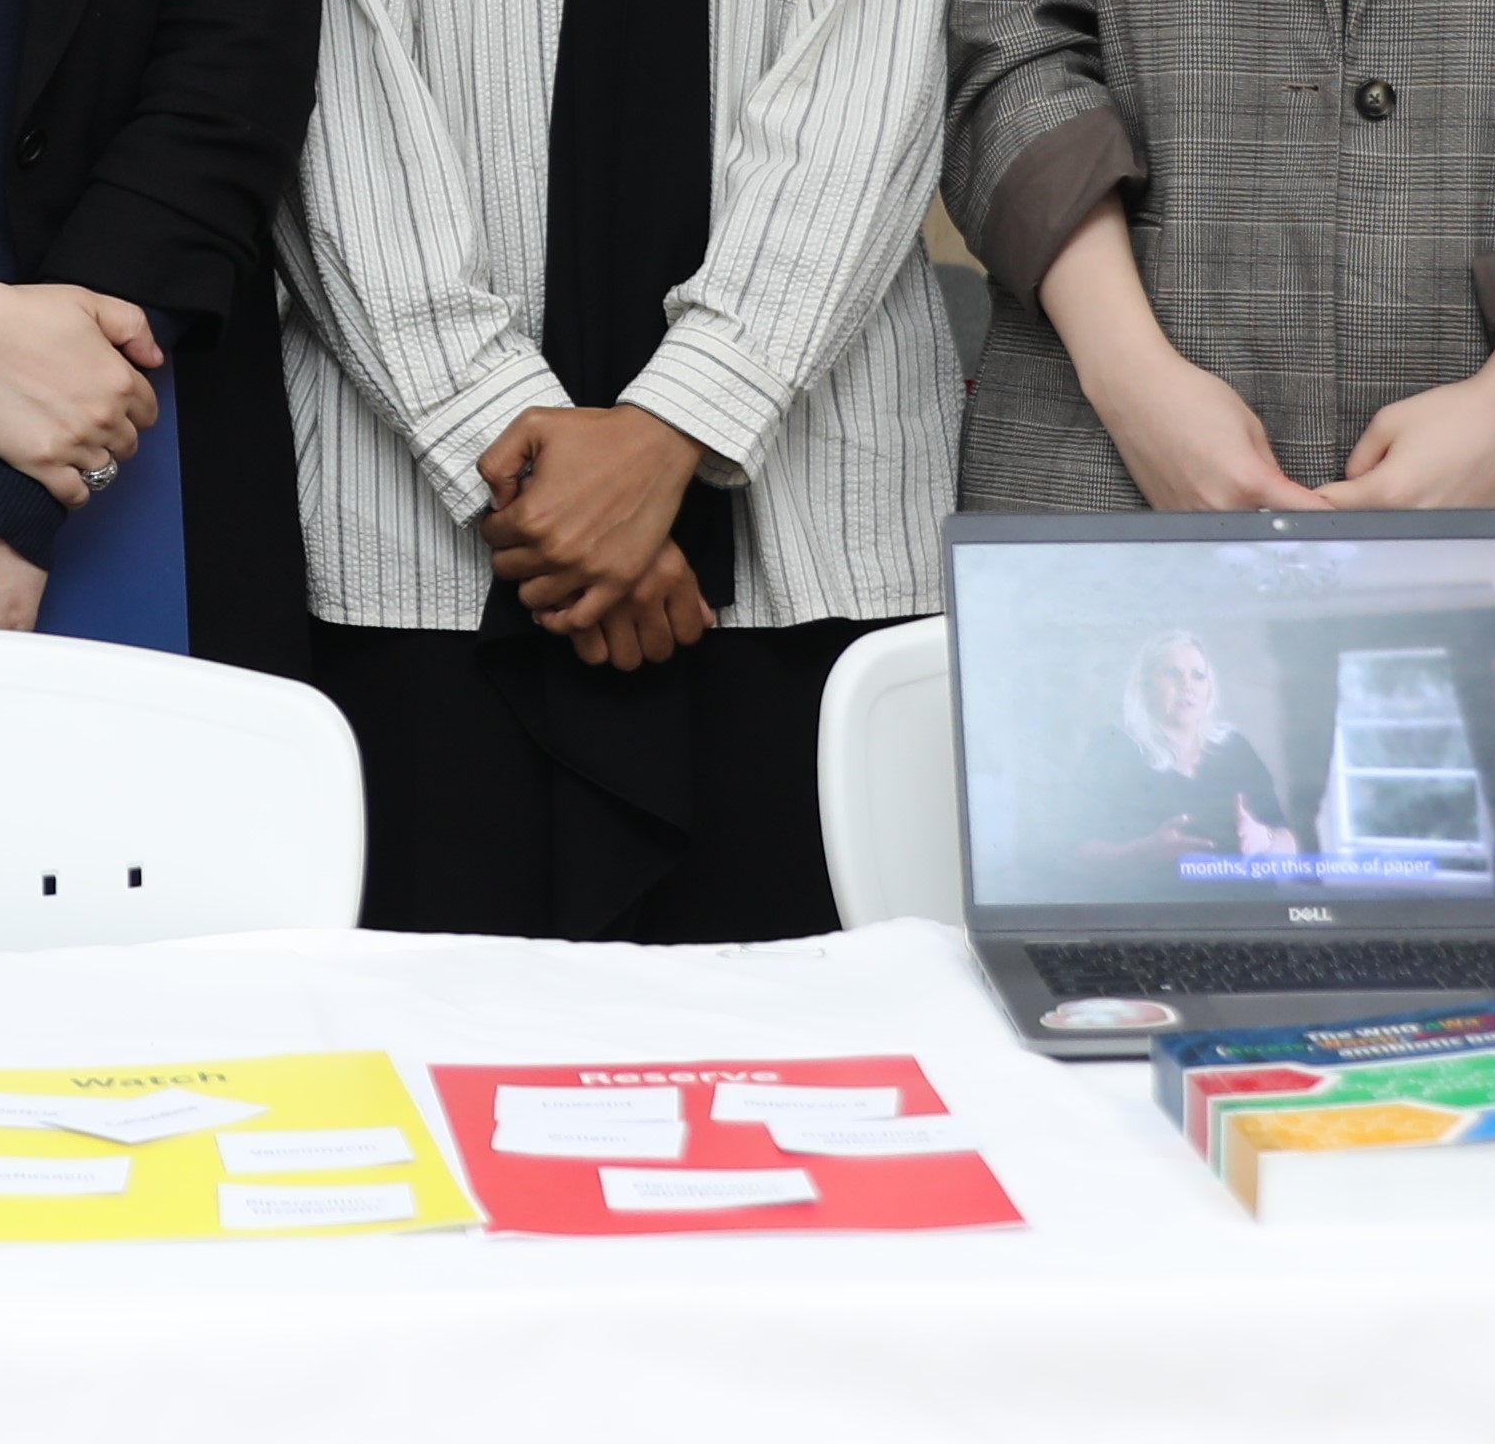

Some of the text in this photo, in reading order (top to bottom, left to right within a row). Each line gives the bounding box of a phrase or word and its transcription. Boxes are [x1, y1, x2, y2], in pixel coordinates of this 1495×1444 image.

[1180, 858, 1432, 878] months, got this piece of paper
[1287, 907, 1333, 922] DELL
[1304, 1029, 1352, 1042] The
[1355, 1022, 1421, 1036] WHO
[1338, 1038, 1464, 1060] antibiotic
[70, 1071, 227, 1089] Watch
[578, 1072, 778, 1085] Reserve
